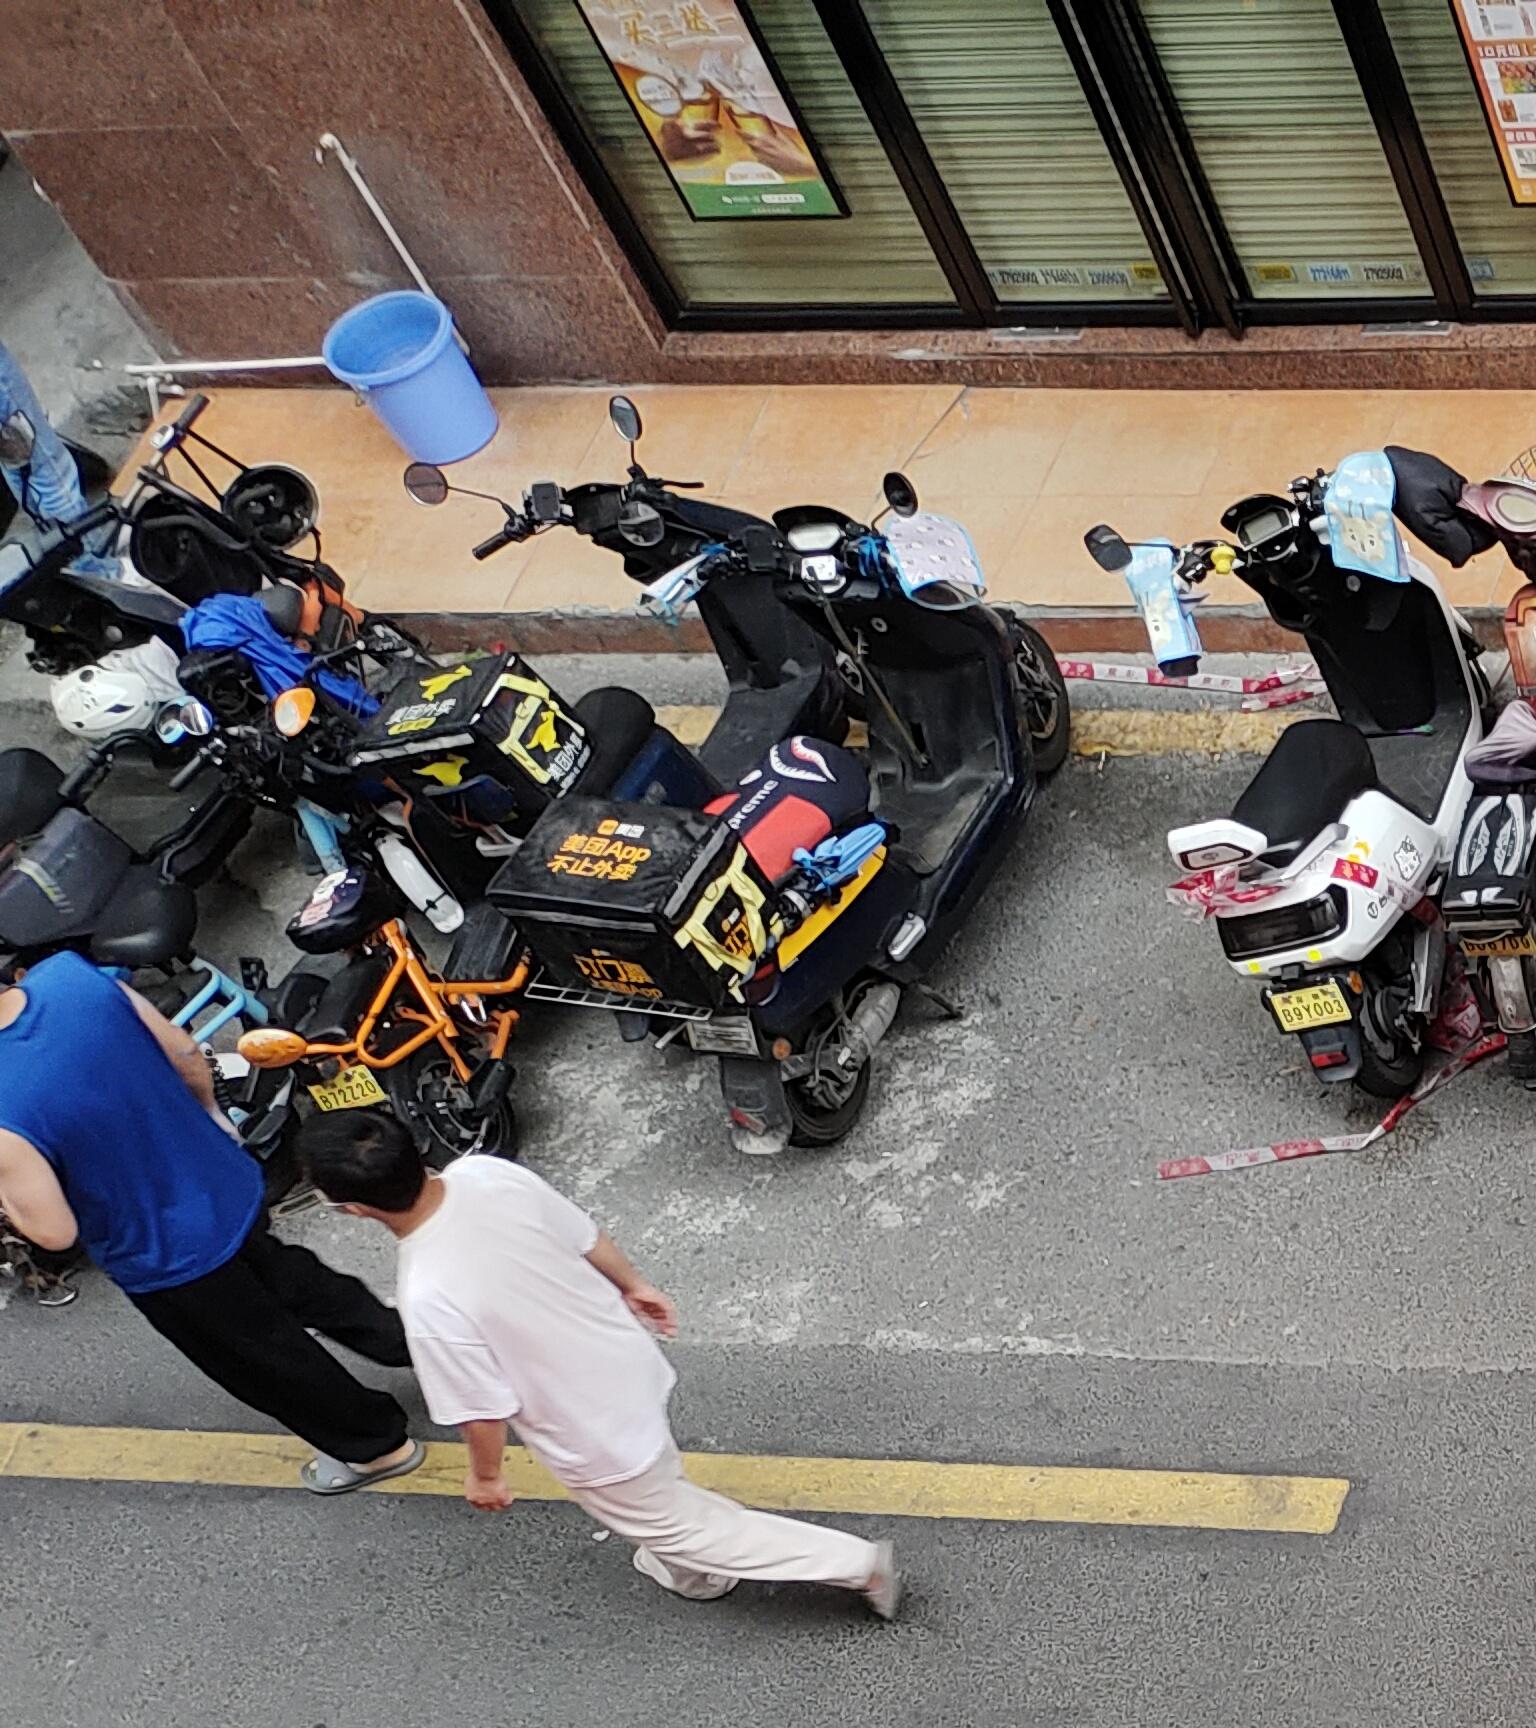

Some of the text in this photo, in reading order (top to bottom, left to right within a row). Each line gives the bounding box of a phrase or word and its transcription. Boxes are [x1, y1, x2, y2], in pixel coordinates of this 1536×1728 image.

[728, 780, 780, 830] preme
[559, 833, 652, 863] 美团App
[546, 854, 639, 880] 不止外卖
[1282, 998, 1344, 1024] B9Y003
